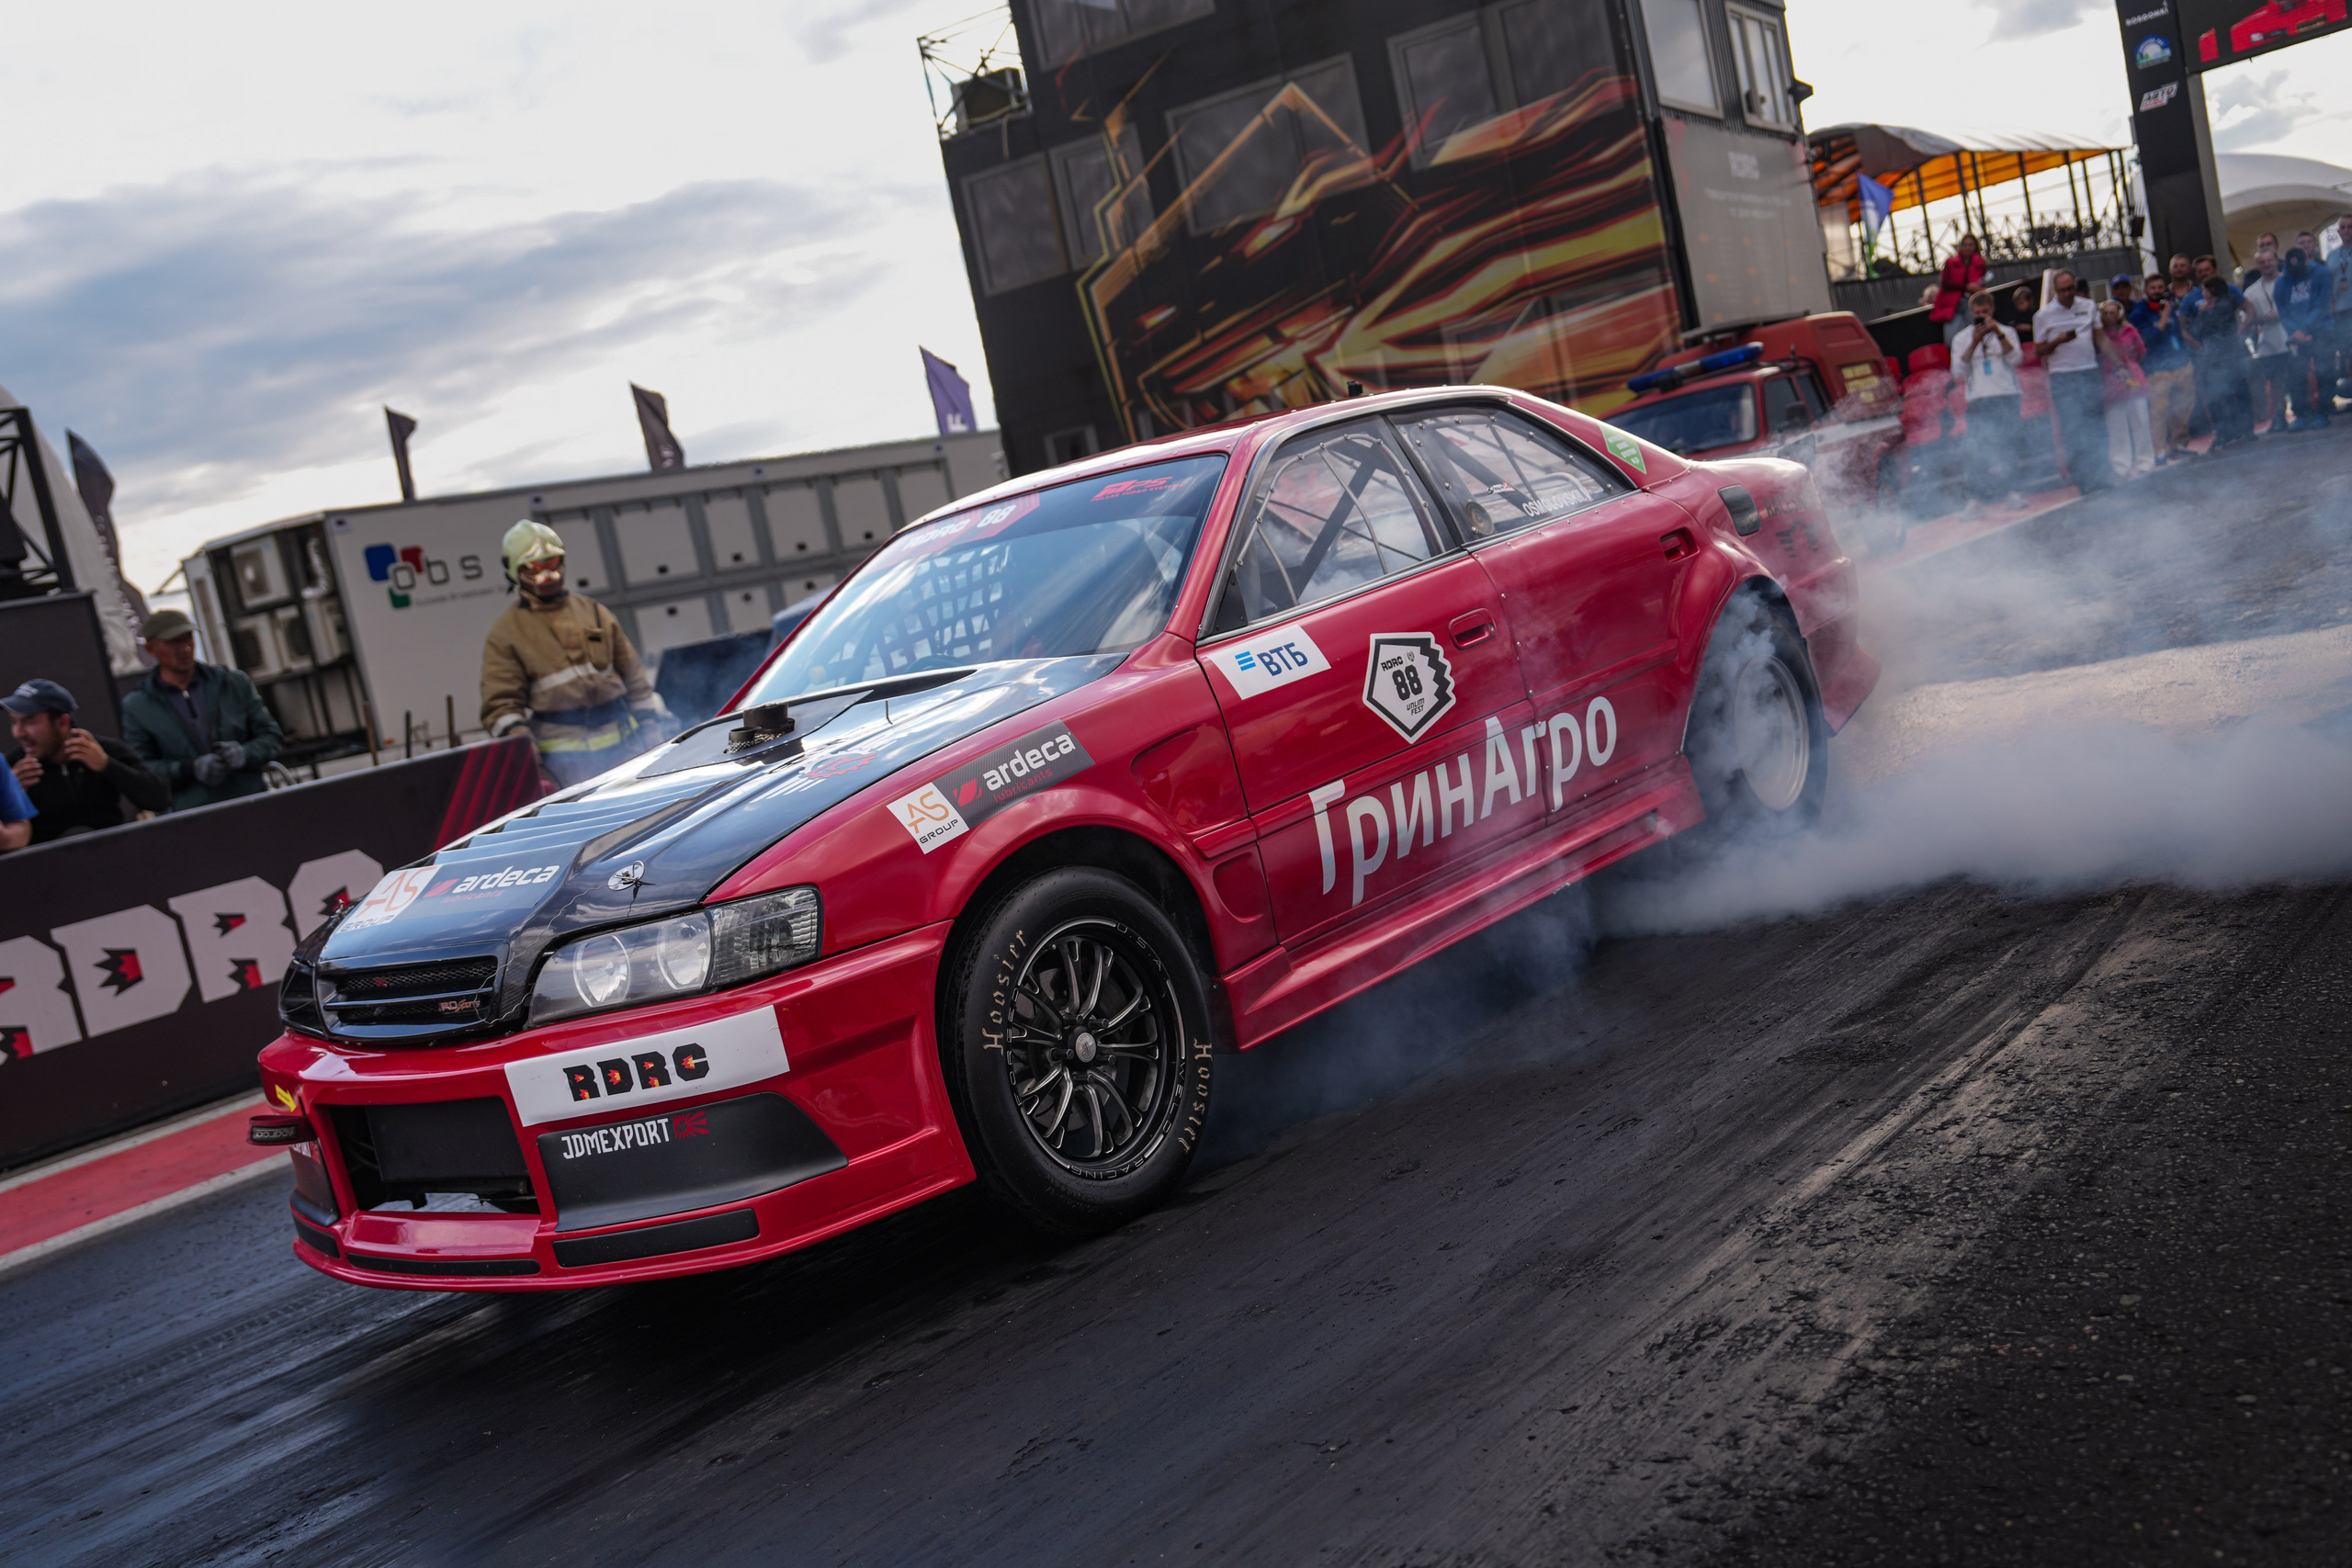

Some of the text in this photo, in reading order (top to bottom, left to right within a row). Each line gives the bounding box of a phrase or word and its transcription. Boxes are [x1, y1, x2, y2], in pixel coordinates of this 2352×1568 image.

[1123, 488, 1148, 496] TURBO
[901, 504, 1017, 551] RDRC 88
[1256, 641, 1308, 677] ВТБ
[1380, 654, 1404, 672] RDRC
[1392, 664, 1423, 701] 88
[1410, 704, 1424, 716] FEST
[982, 734, 1076, 791] ardeca
[993, 768, 1053, 804] lubricants
[1308, 696, 1617, 908] ГринАгро
[919, 818, 958, 844] GROUP
[452, 865, 560, 894] ardeca
[342, 914, 395, 932] GROUP
[981, 930, 1027, 1056] Hoosier
[562, 1043, 710, 1102] RDRC
[1177, 1038, 1214, 1153] Hoosier
[561, 1118, 670, 1160] JDMEXPORT
[1069, 1156, 1145, 1180] RACING
